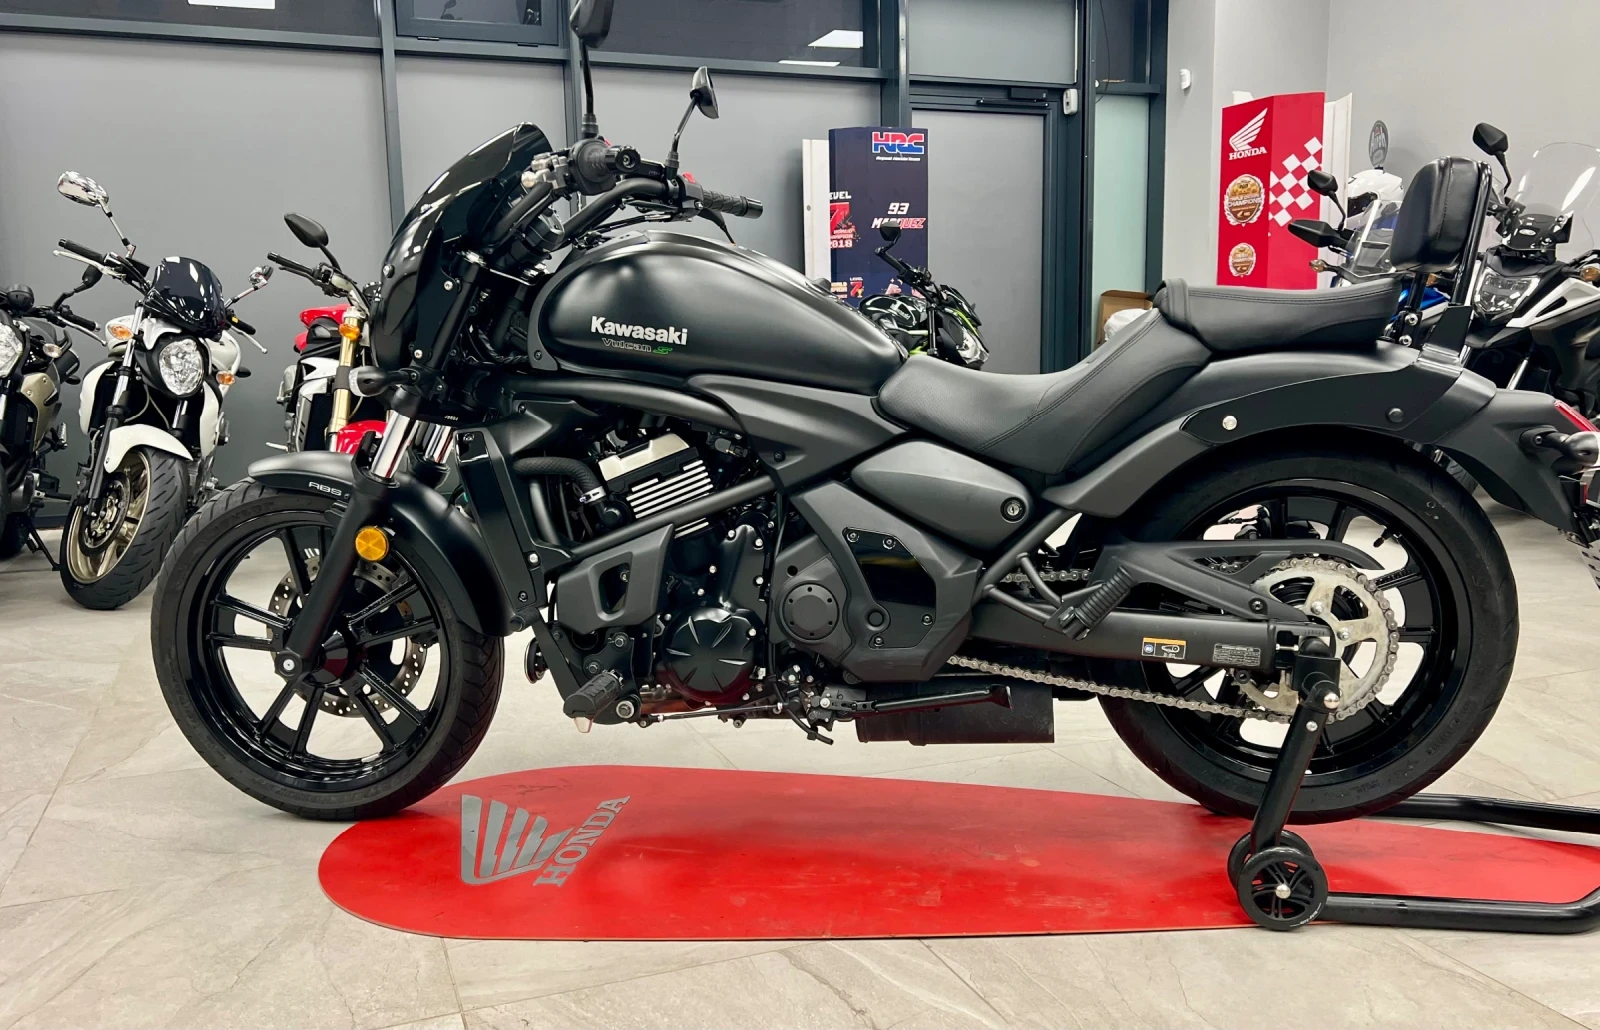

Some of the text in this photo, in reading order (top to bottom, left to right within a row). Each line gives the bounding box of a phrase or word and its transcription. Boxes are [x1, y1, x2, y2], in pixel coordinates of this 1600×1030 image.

[872, 132, 924, 154] HRC
[1229, 147, 1267, 160] HONDA
[888, 203, 909, 214] 93
[591, 316, 687, 345] Kawasaki
[602, 338, 673, 355] Vulcan S
[308, 481, 342, 496] ABS
[532, 795, 631, 887] HONDA
